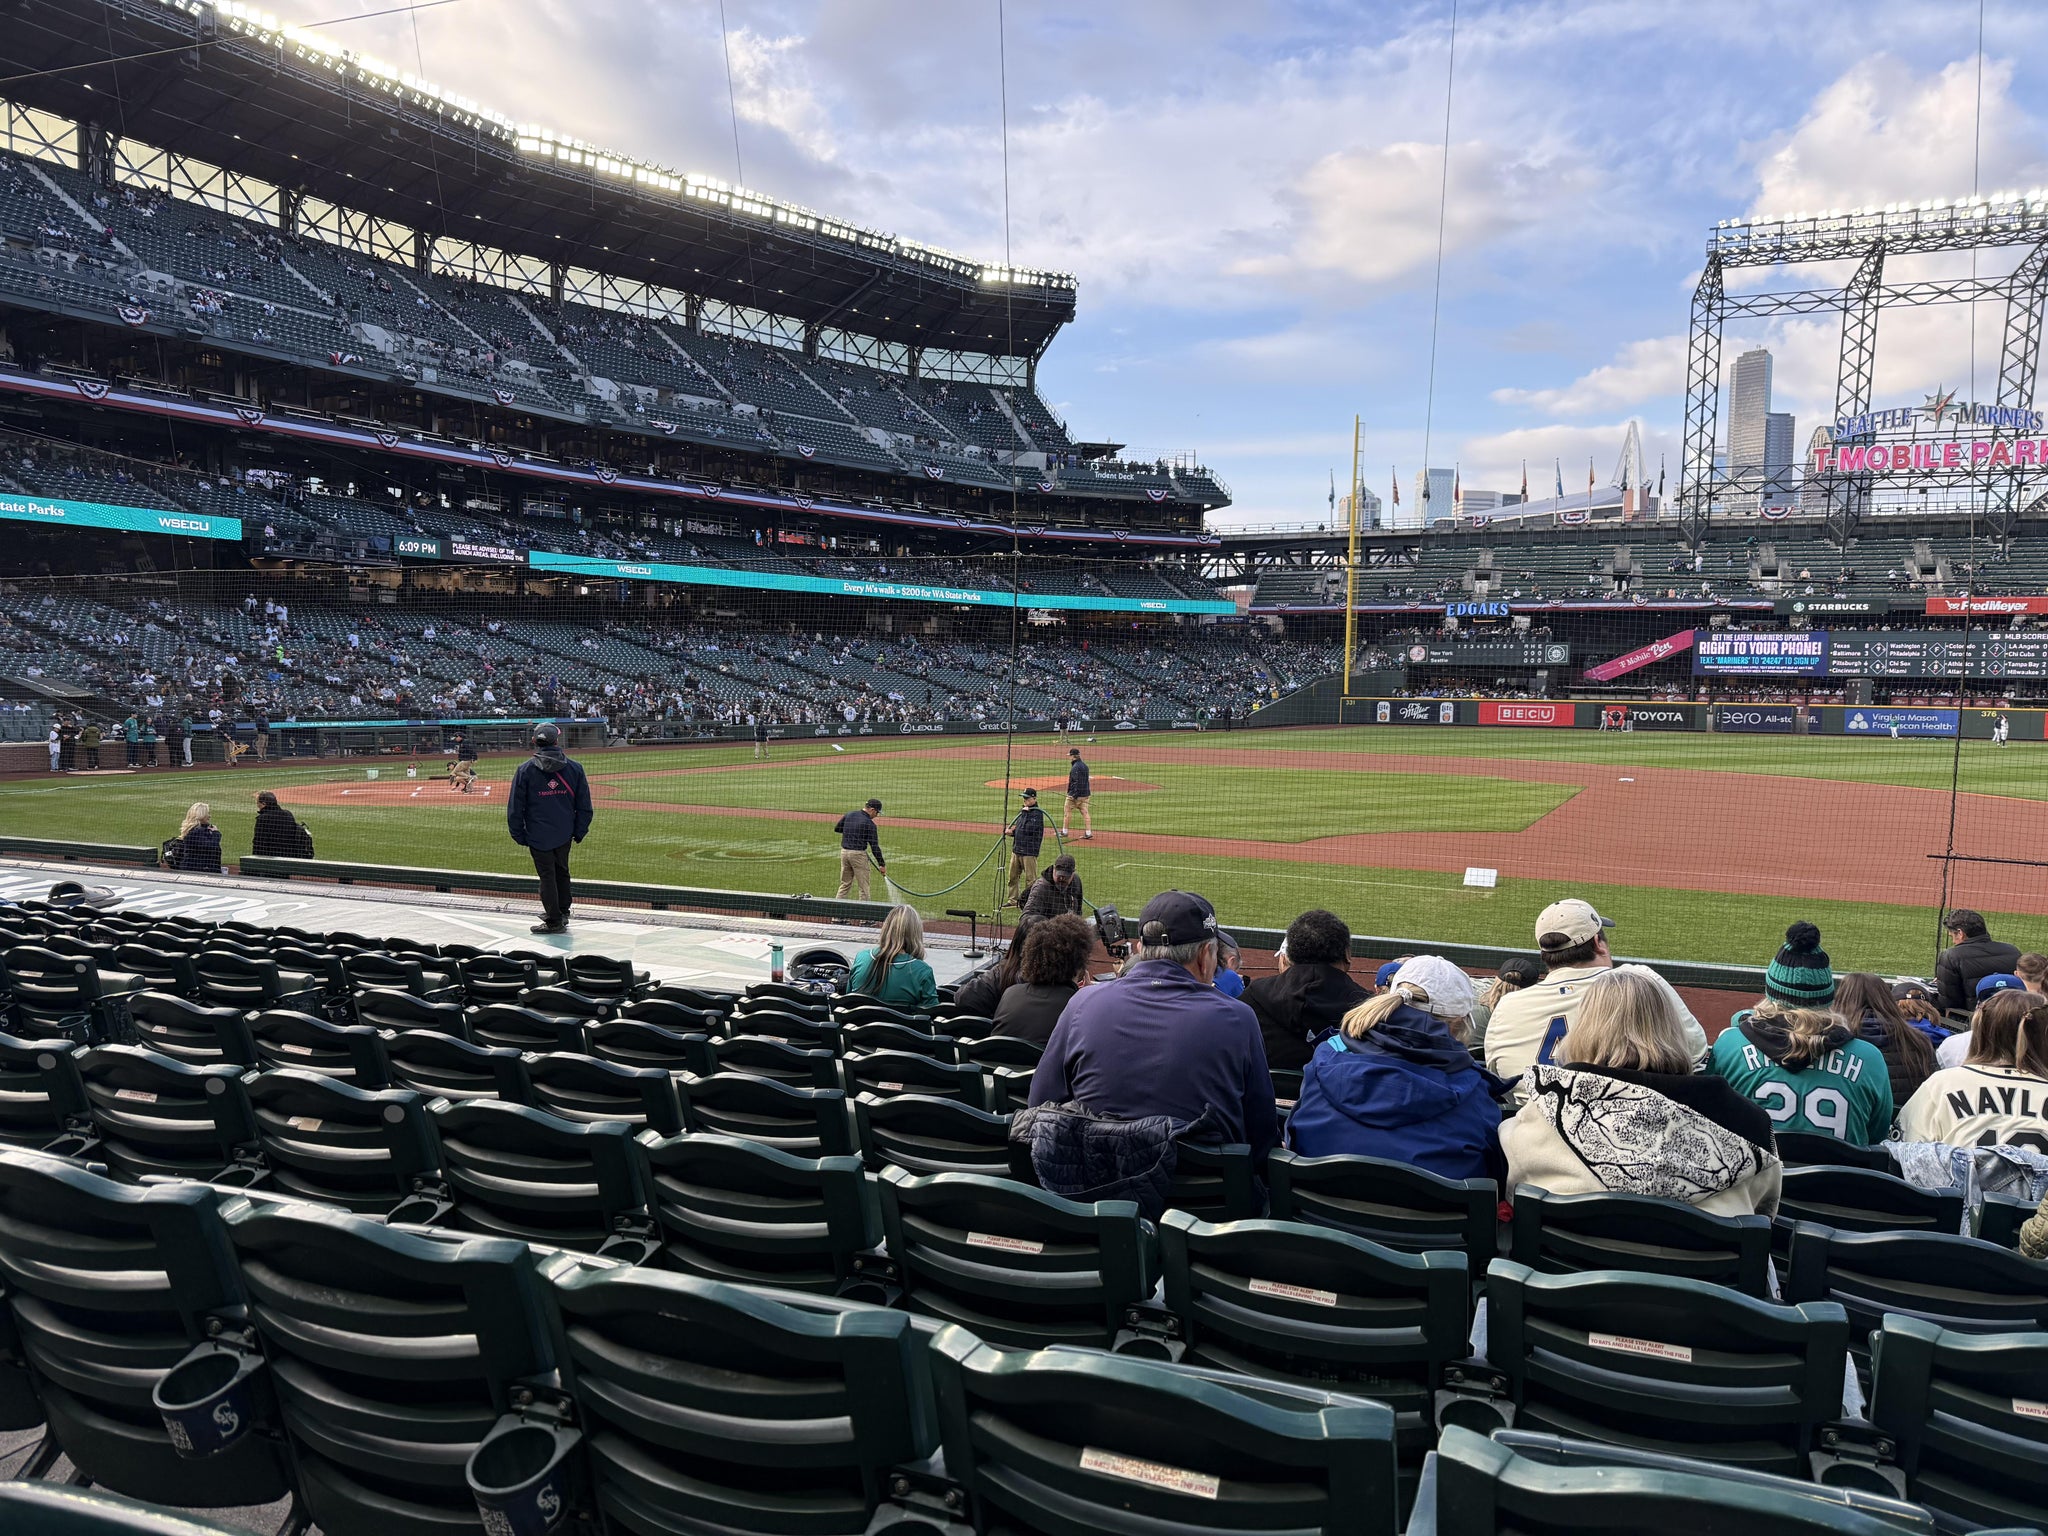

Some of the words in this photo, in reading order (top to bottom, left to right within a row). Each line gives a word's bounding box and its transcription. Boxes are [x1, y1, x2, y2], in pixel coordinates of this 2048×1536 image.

[1835, 407, 1912, 439] SEATTLE
[1958, 401, 2044, 431] MARINERS
[1813, 442, 1961, 473] T-MOBILE
[1094, 471, 1117, 480] Trident
[1118, 472, 1134, 480] Deck
[0, 502, 26, 513] tate
[28, 502, 65, 517] Parks
[158, 517, 209, 532] WSECU
[399, 541, 419, 552] 6:09
[422, 544, 436, 554] PM
[617, 565, 651, 575] WSECU
[843, 582, 863, 593] Every
[865, 584, 877, 593] M's
[879, 586, 895, 594] walk
[902, 587, 919, 596] $200
[932, 590, 944, 598] WA
[945, 591, 962, 599] State
[963, 593, 981, 601] Parks
[1447, 603, 1508, 616] EDGAR'S
[1626, 652, 1651, 666] Mobile
[1650, 642, 1673, 658] Pen
[1699, 642, 1731, 654] RIGHT
[1733, 642, 1746, 654] TO
[1749, 642, 1778, 655] YOUR
[1781, 642, 1822, 655] PHONE!
[1632, 711, 1683, 722] TOYOTA
[1722, 712, 1761, 725] eero
[979, 722, 999, 730] Great
[1755, 1081, 1848, 1140] 29
[1641, 1346, 1663, 1354] LEAVING
